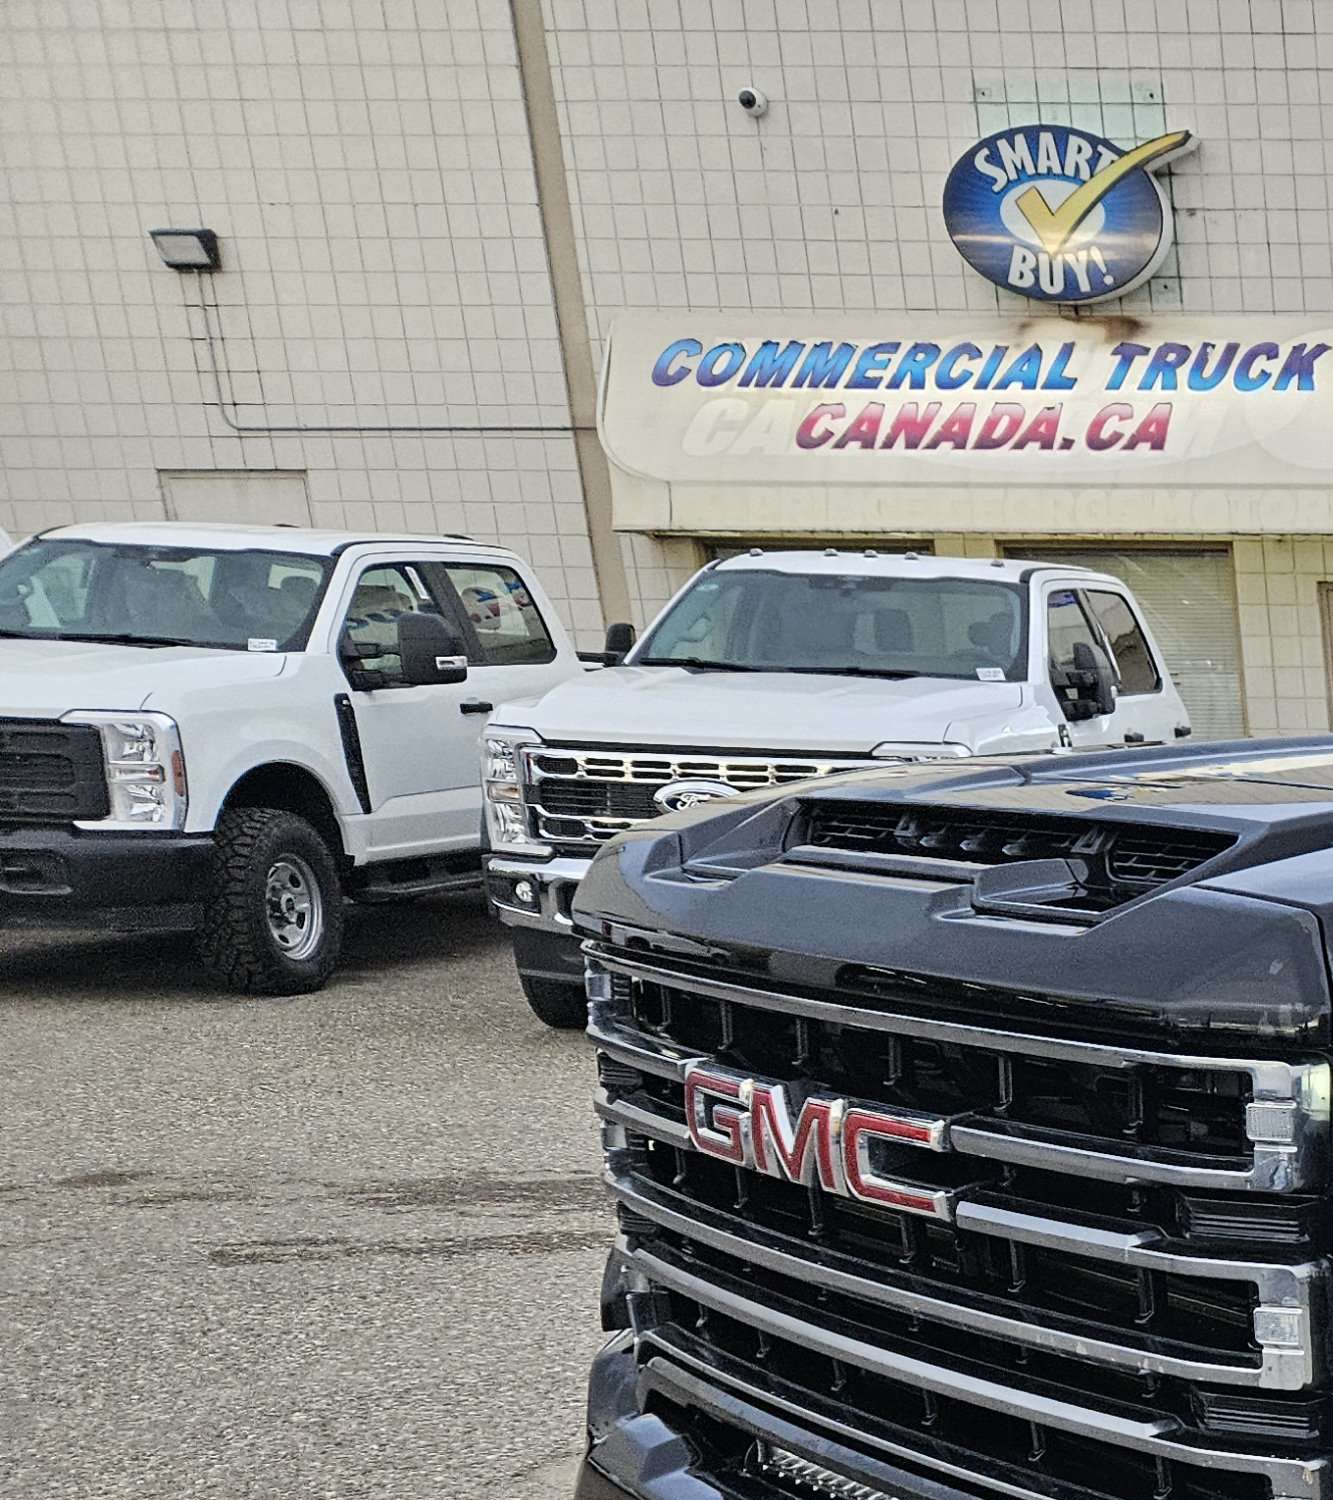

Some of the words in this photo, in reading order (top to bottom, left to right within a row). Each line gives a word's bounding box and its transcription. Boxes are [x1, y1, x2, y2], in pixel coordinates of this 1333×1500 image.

[974, 132, 1121, 193] SMART
[1007, 244, 1114, 294] BUY!
[651, 336, 1079, 391] COMMERCIAL
[1103, 341, 1333, 392] TRUCK
[794, 400, 1173, 452] CANADA.CA
[684, 1063, 951, 1223] GMC
